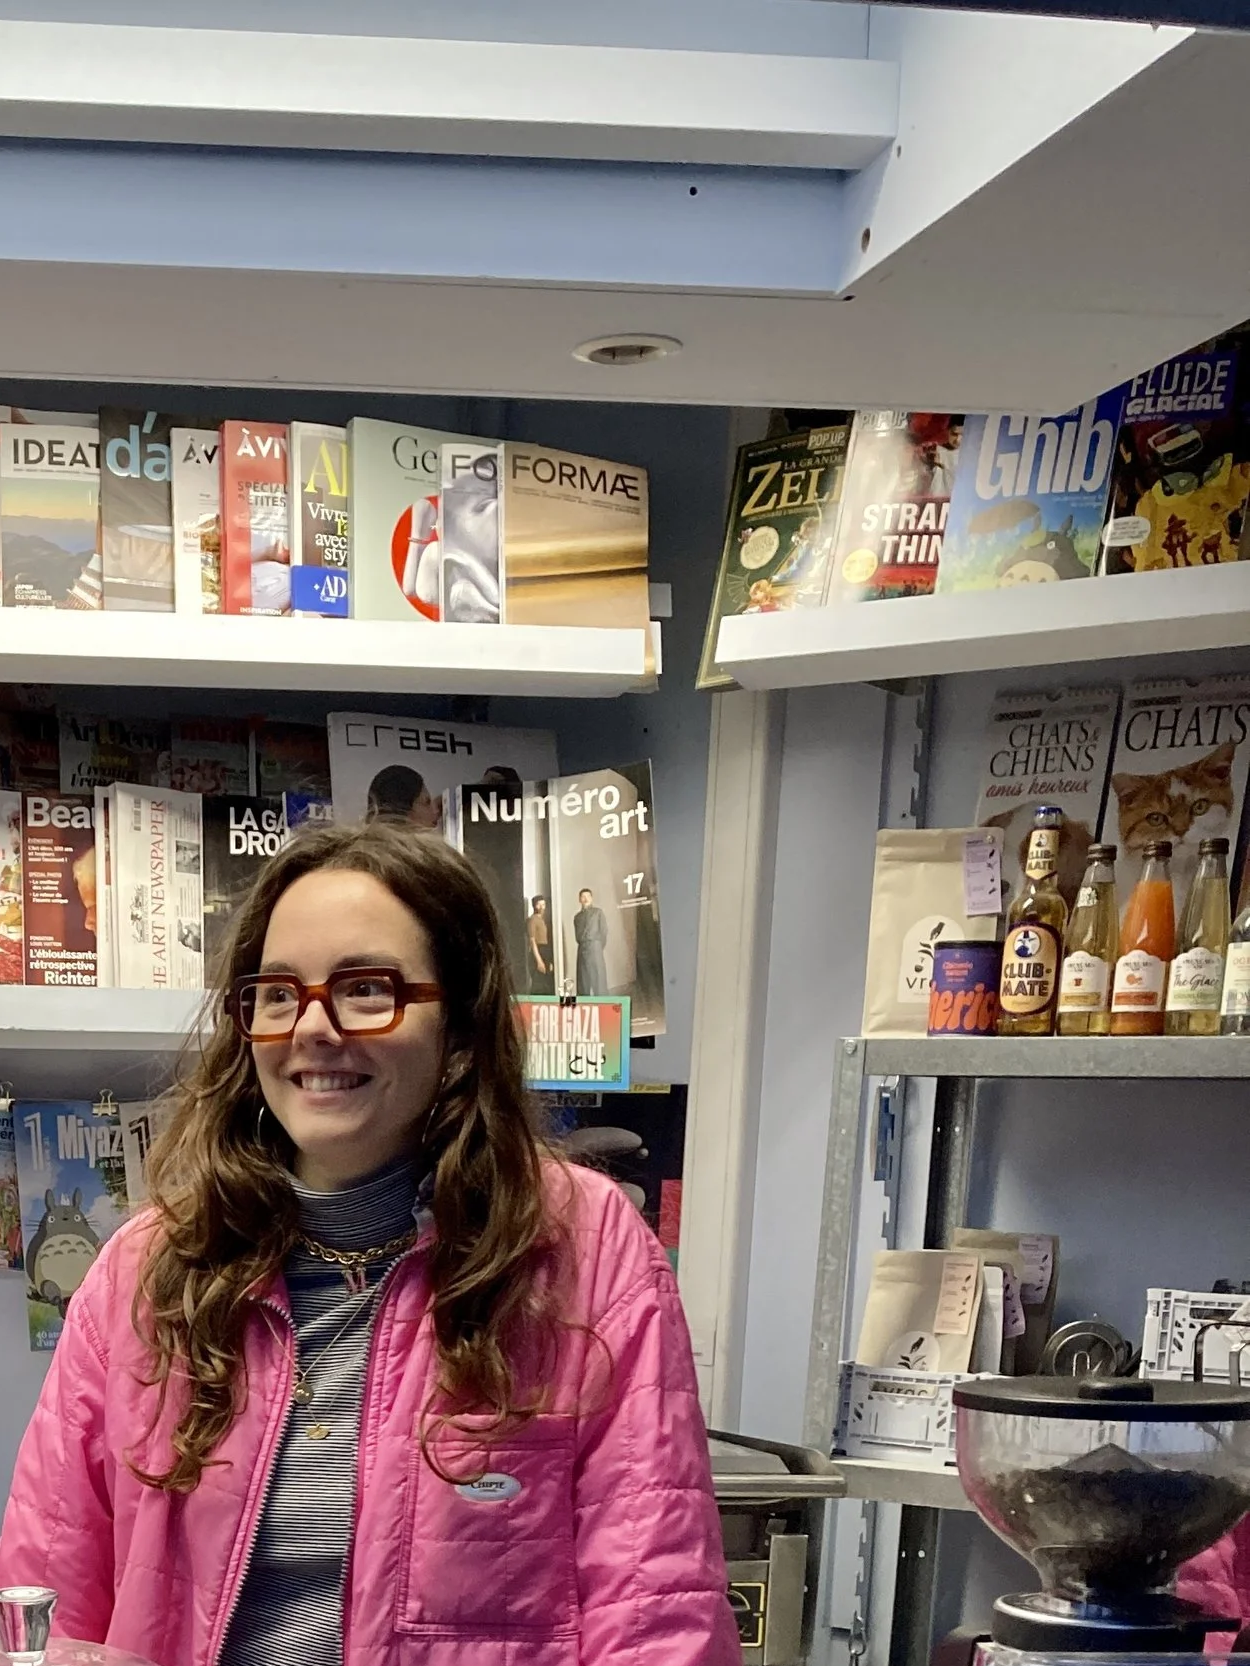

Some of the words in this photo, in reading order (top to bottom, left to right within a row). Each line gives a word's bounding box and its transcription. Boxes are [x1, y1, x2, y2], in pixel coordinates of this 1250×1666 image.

[1008, 718, 1091, 750] CHATS
[988, 745, 1096, 779] CHIENS
[26, 796, 95, 830] Bea
[469, 783, 621, 824] Numéro
[598, 801, 650, 841] art
[149, 800, 166, 917] NEWSPAPER
[622, 871, 645, 897] 17
[1001, 979, 1049, 998] MATE
[531, 1004, 560, 1043] FOR
[561, 1004, 601, 1043] GAZA
